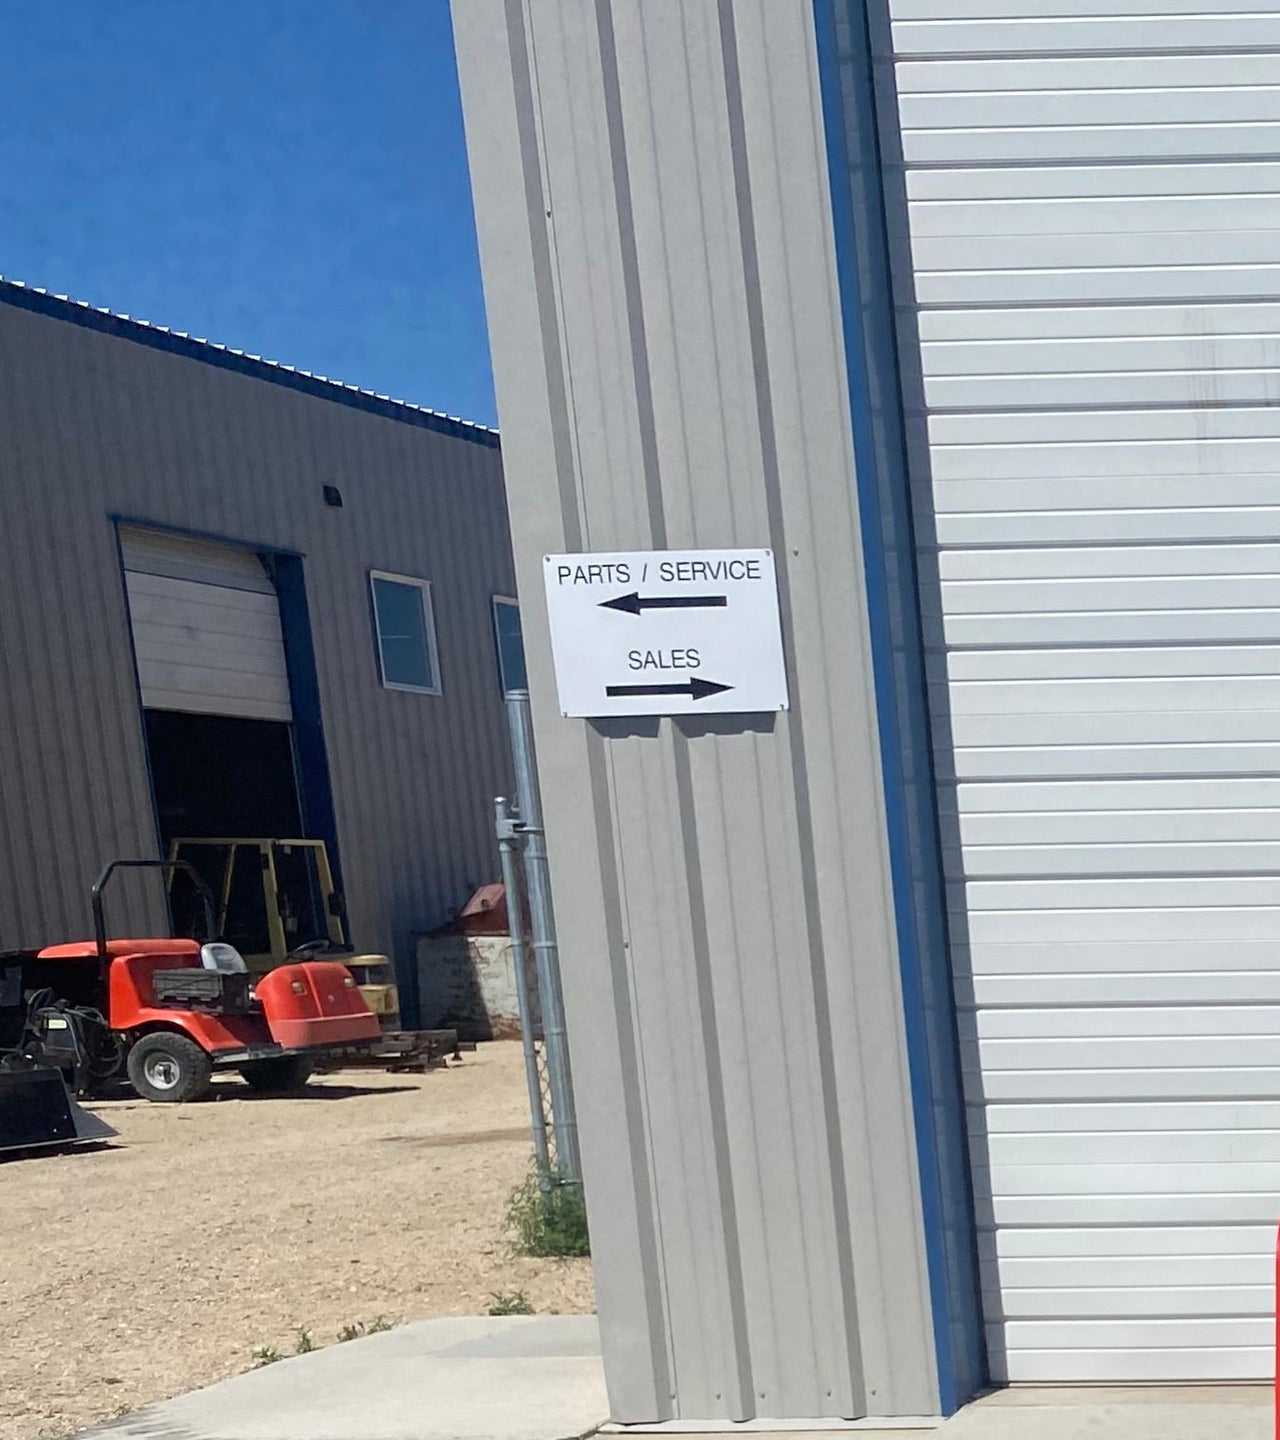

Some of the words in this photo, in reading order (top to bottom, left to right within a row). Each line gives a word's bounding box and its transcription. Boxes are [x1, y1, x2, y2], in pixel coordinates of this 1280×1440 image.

[558, 564, 630, 584] PARTS
[642, 563, 647, 582] /
[660, 560, 761, 581] SERVICE
[628, 649, 700, 670] SALES
